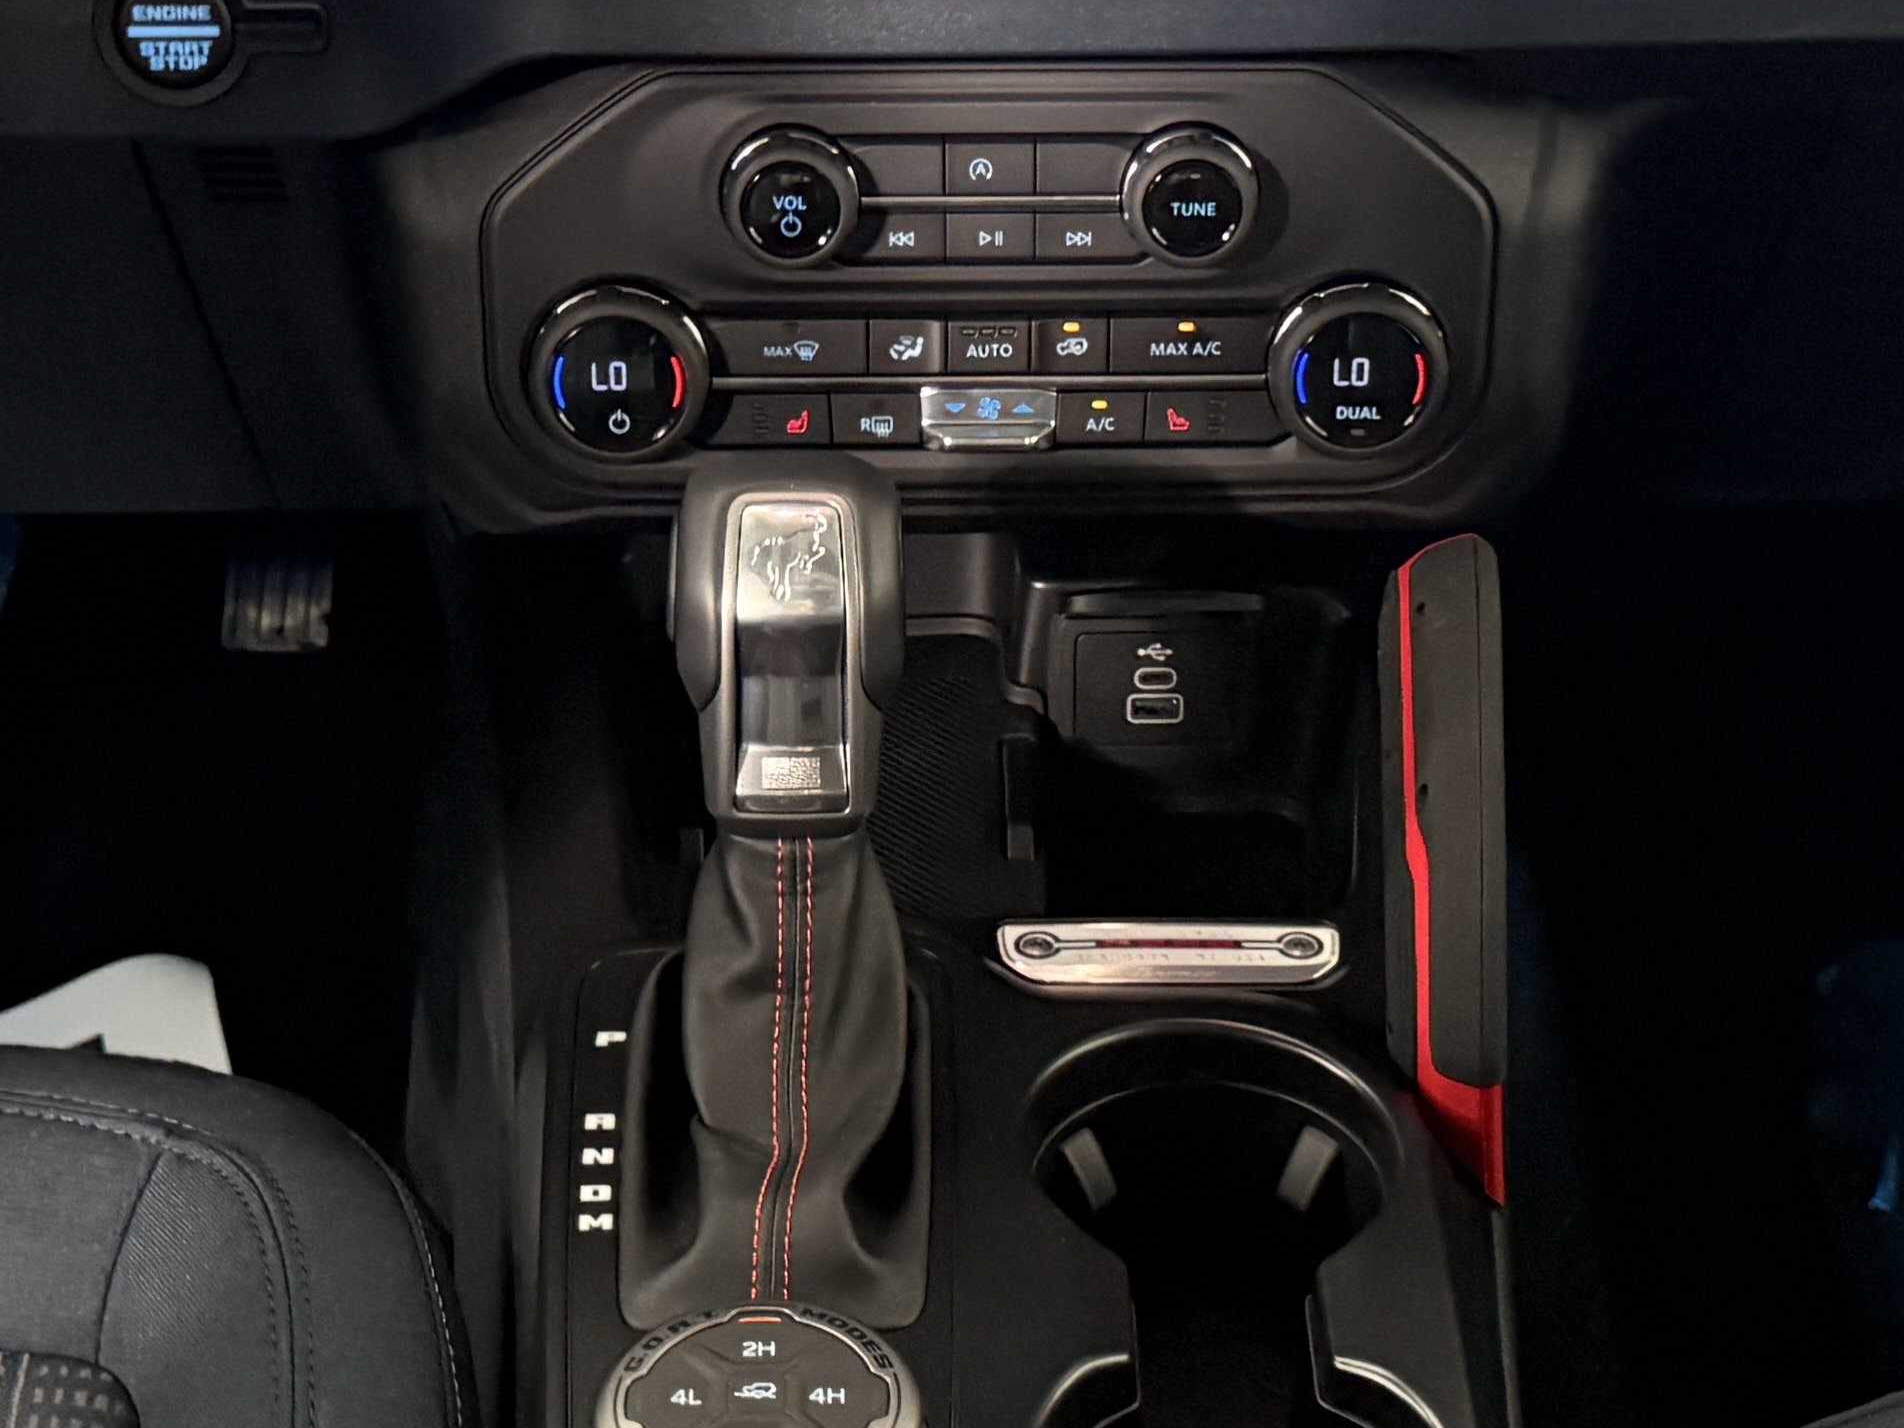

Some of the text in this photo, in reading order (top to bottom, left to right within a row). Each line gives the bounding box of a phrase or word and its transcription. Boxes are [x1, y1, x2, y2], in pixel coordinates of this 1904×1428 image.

[131, 4, 212, 22] ENGINE
[138, 39, 214, 57] START
[149, 56, 208, 72] STOP
[772, 196, 807, 211] VOL
[1170, 202, 1217, 218] TUNE
[763, 345, 793, 358] MAX
[965, 343, 1013, 359] AUTO
[1150, 341, 1221, 357] MAX A/C
[1335, 405, 1381, 421] DUAL
[860, 417, 873, 432] R
[1085, 417, 1115, 432] A/C
[581, 1147, 614, 1165] N
[578, 1184, 613, 1201] D
[578, 1213, 614, 1231] M
[801, 1307, 895, 1371] MODES
[741, 1340, 776, 1357] 2H
[669, 1389, 703, 1406] 4L
[808, 1387, 846, 1405] 4H
